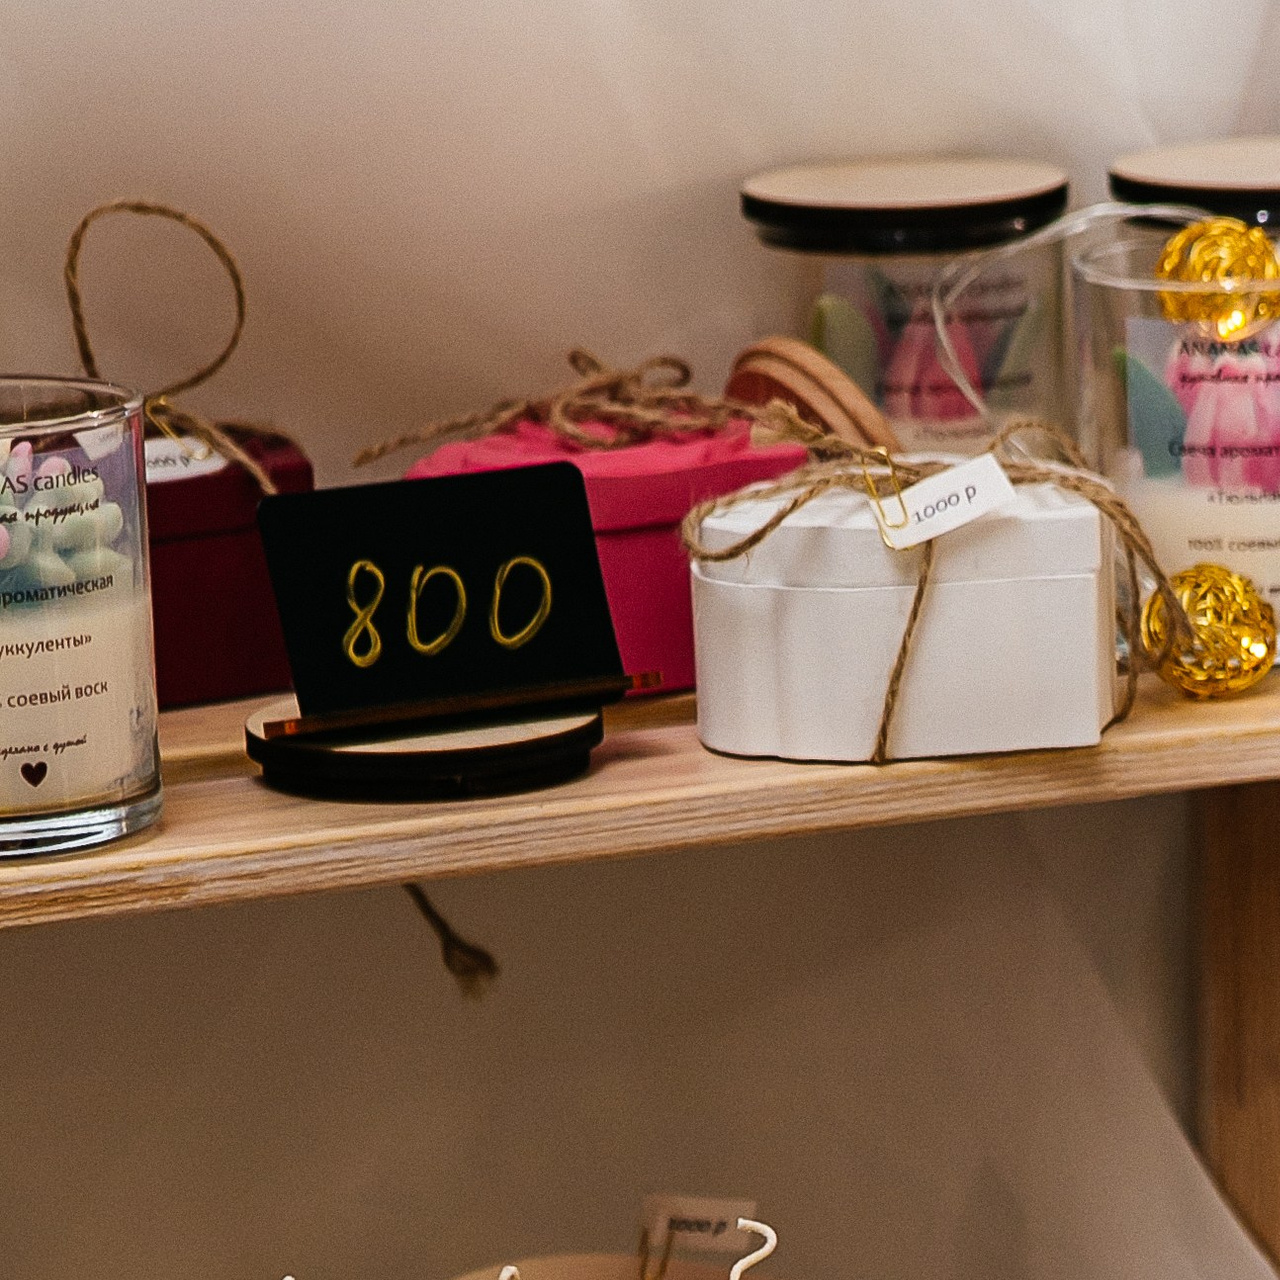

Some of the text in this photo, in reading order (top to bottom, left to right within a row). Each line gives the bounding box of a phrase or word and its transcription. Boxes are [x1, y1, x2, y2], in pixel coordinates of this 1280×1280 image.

[33, 465, 99, 492] candles
[25, 499, 100, 527] продукция
[914, 492, 961, 524] 1000
[342, 555, 552, 668] 800
[7, 681, 109, 708] соевый воск
[0, 744, 40, 760] делано
[53, 734, 87, 755] душой
